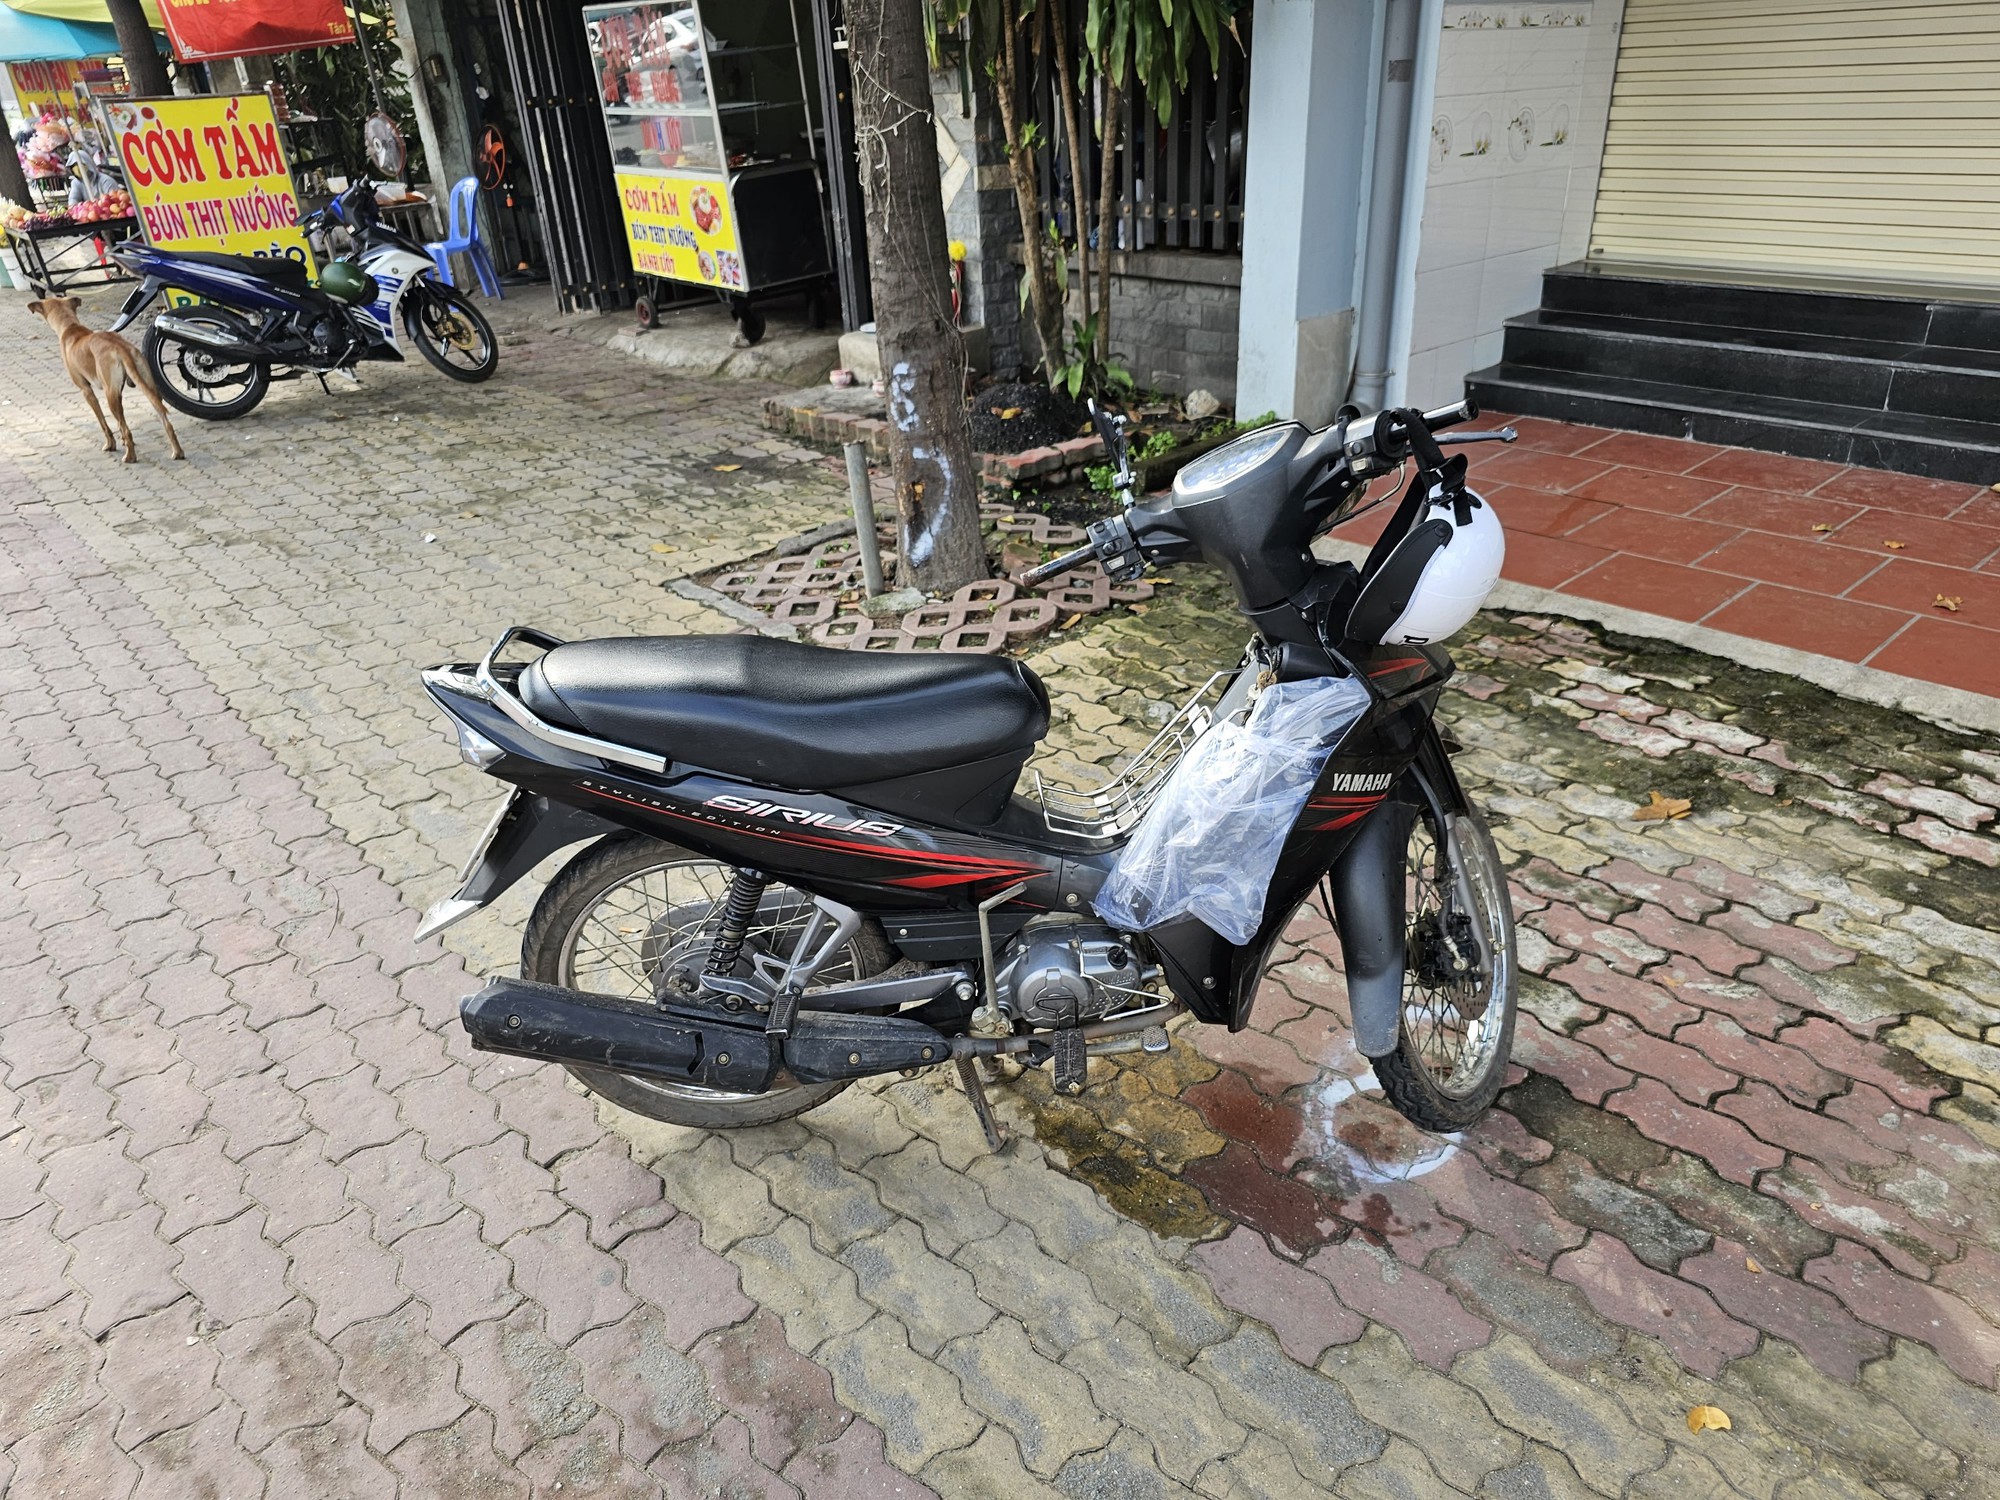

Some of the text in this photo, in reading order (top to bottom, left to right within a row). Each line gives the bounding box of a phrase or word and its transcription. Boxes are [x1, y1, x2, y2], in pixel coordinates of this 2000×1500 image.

[122, 98, 286, 187] CƠM TẤM
[143, 185, 299, 246] BÚN THỊT NƯỚNG
[625, 180, 680, 216] CƠM TẤM
[631, 219, 649, 240] BÚN
[649, 225, 667, 249] THỊT
[1332, 772, 1393, 792] YAMAHA
[703, 795, 905, 838] SIRIUS
